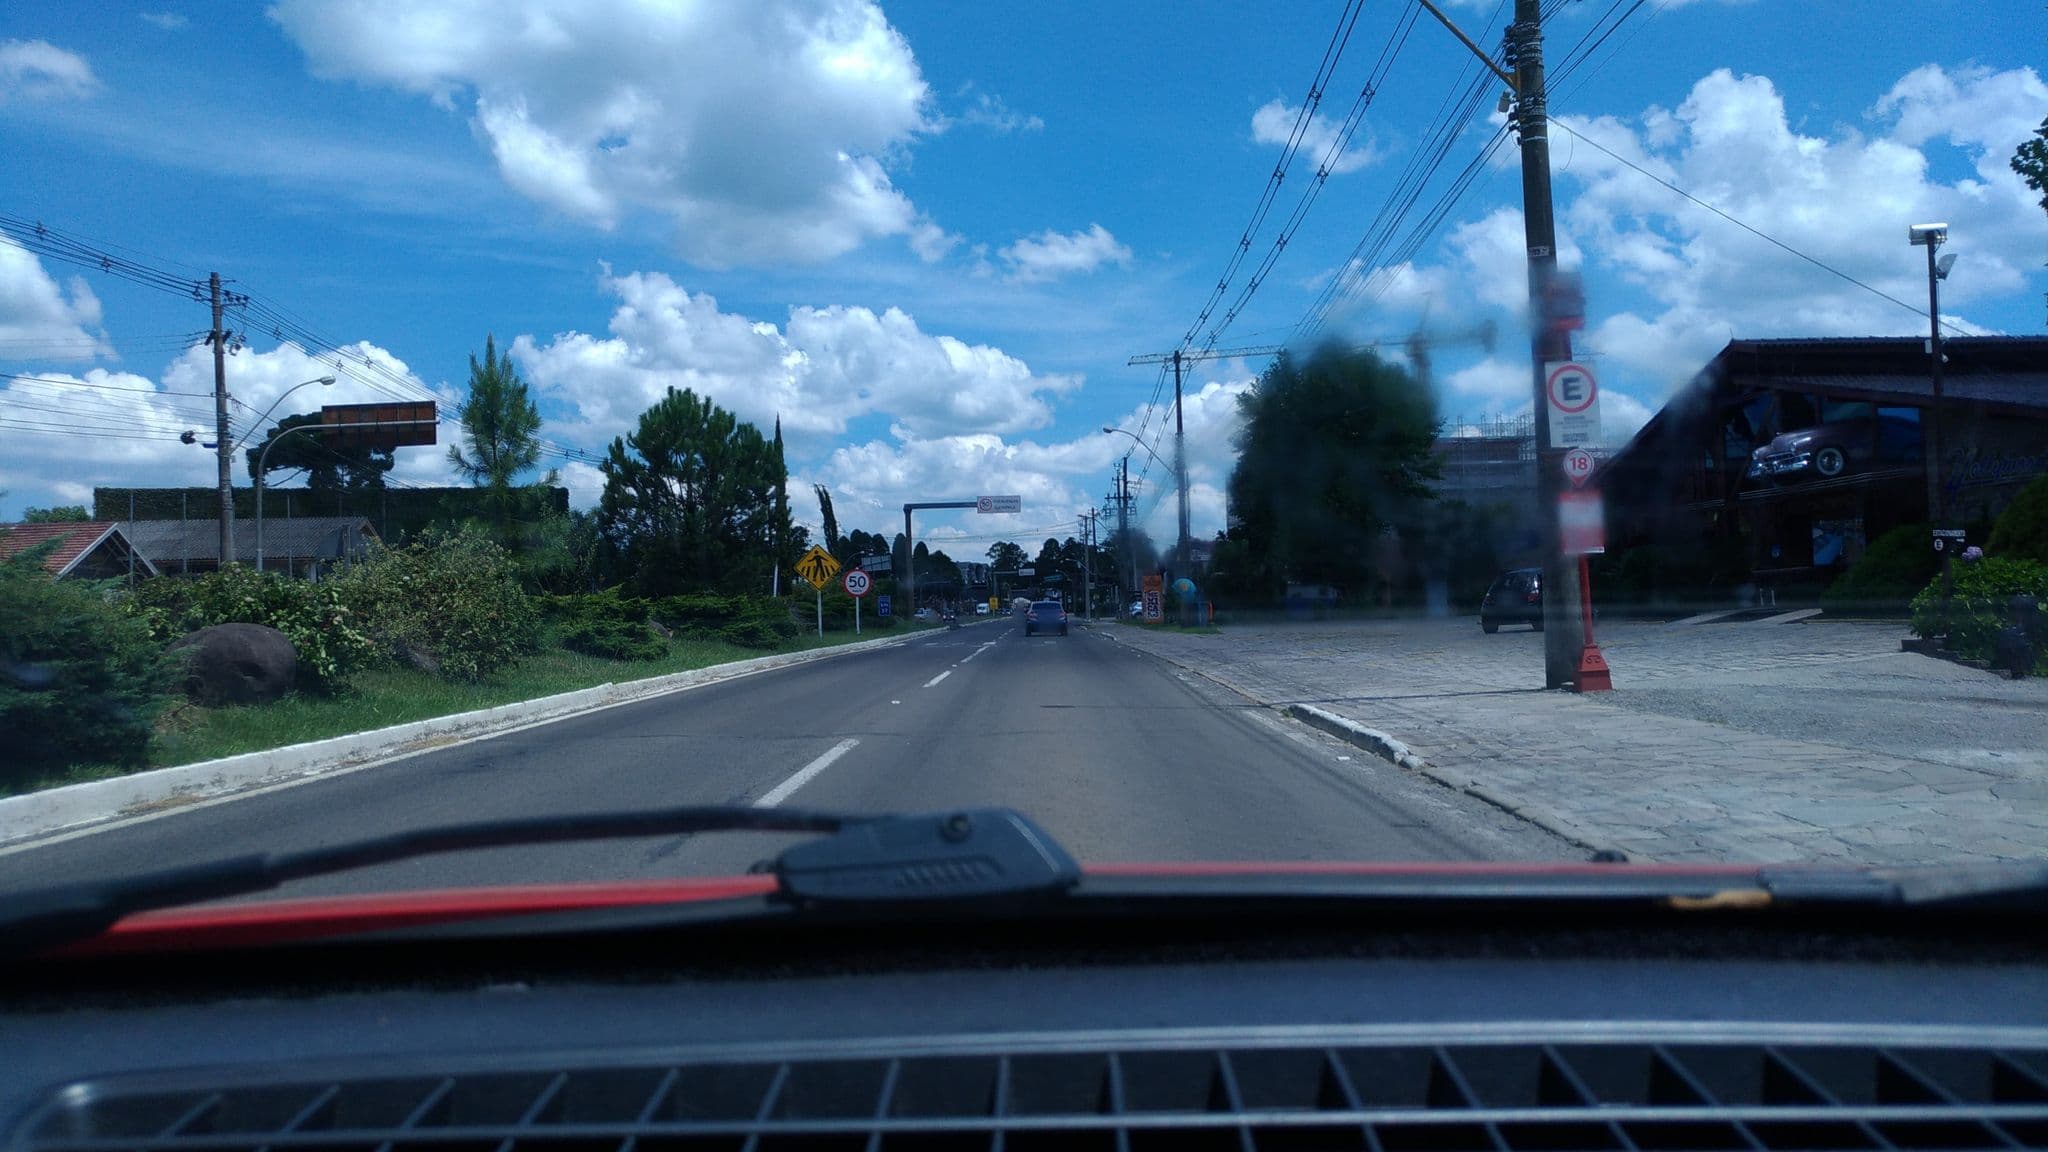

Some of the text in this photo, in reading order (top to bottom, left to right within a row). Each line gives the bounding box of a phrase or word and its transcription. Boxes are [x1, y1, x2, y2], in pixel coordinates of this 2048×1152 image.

[1562, 377, 1582, 401] E
[1569, 457, 1588, 471] 18
[848, 575, 866, 588] 50
